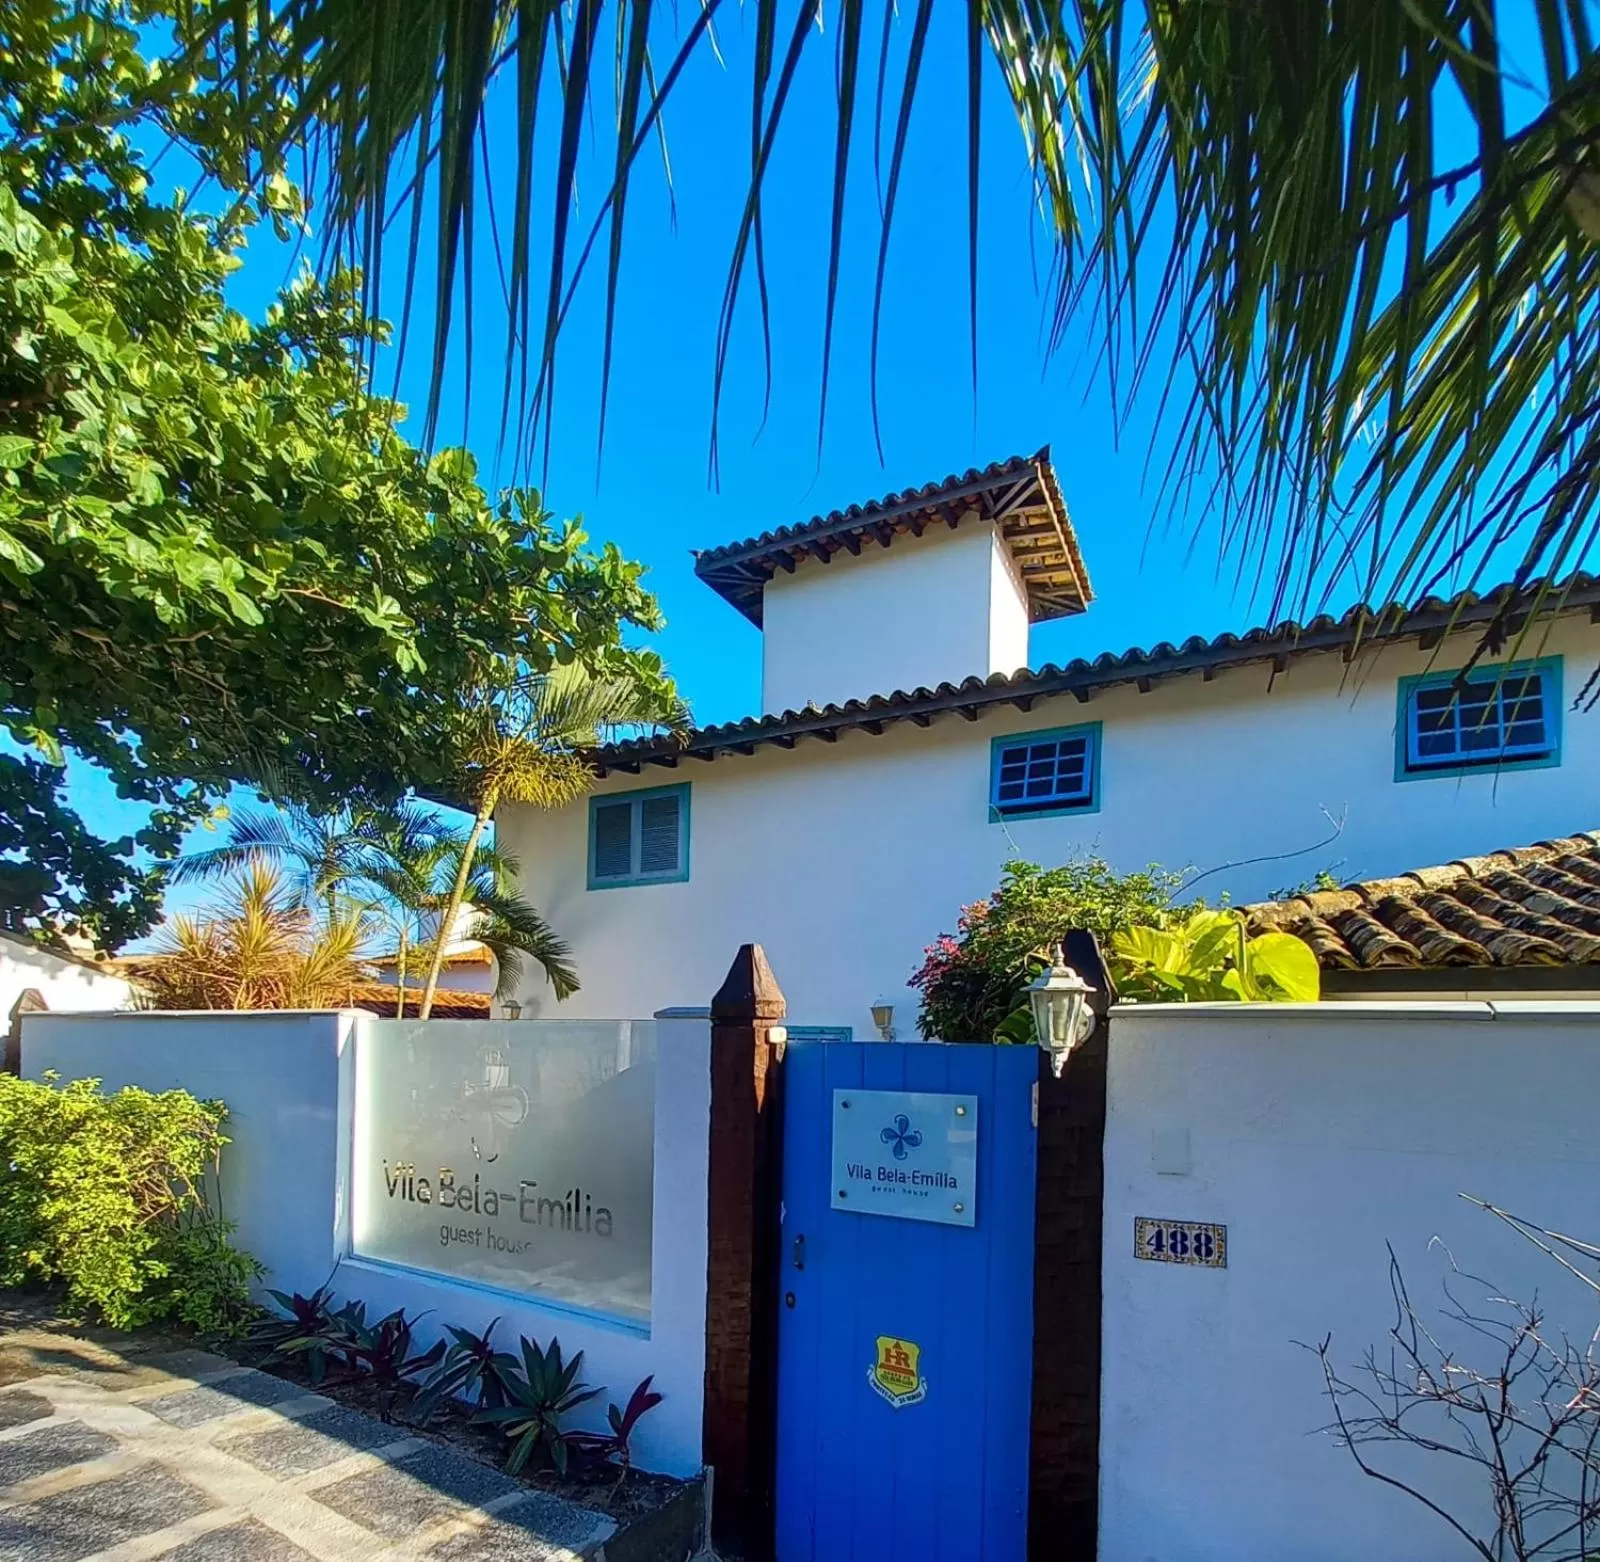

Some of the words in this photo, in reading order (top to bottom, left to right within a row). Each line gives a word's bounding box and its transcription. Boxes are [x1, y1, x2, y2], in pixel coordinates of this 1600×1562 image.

[847, 1163, 872, 1181] Vila
[383, 1160, 431, 1204] Vila
[438, 1166, 613, 1237] Bela-Emília
[440, 1224, 482, 1246] guest
[1146, 1228, 1214, 1258] 488
